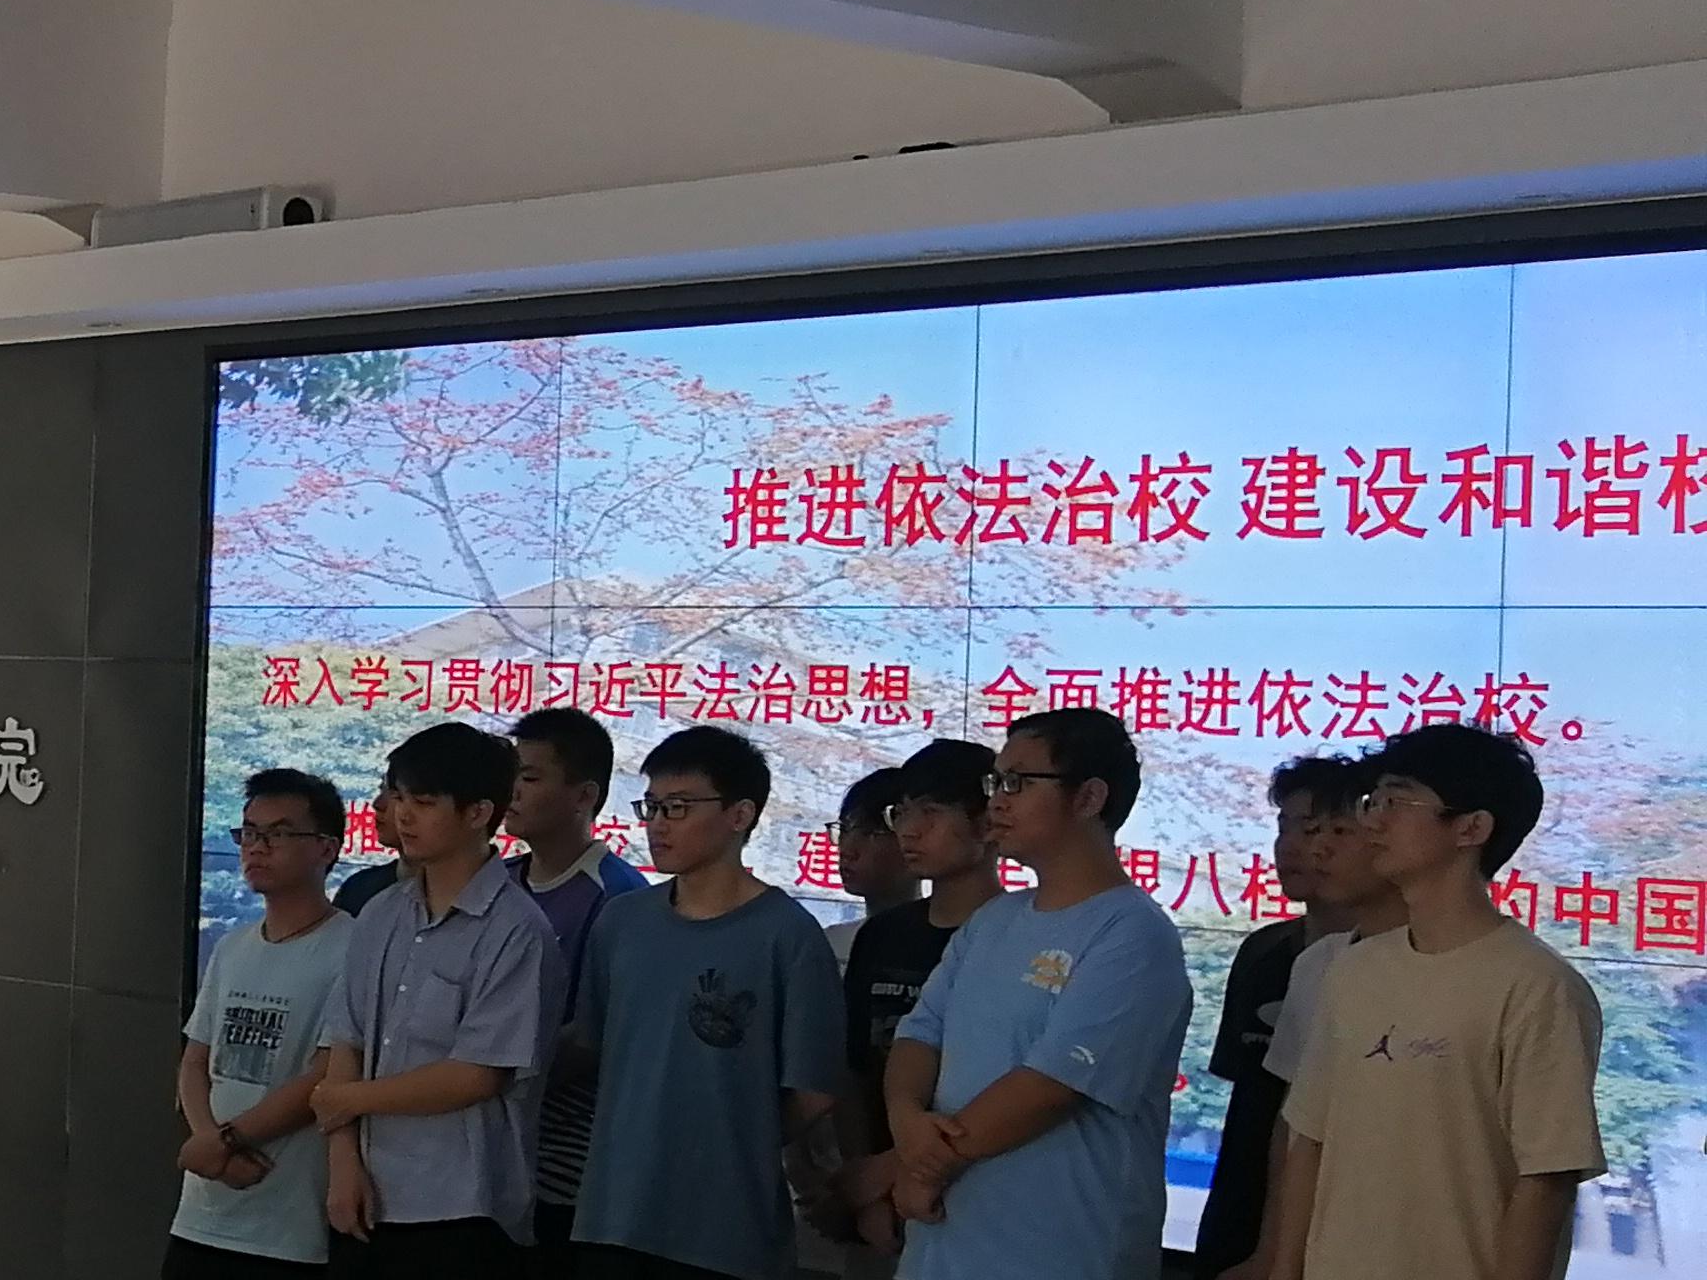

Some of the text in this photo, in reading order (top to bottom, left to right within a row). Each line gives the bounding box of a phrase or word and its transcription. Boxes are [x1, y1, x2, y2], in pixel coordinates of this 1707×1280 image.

[722, 450, 1212, 549] 推进依法治校
